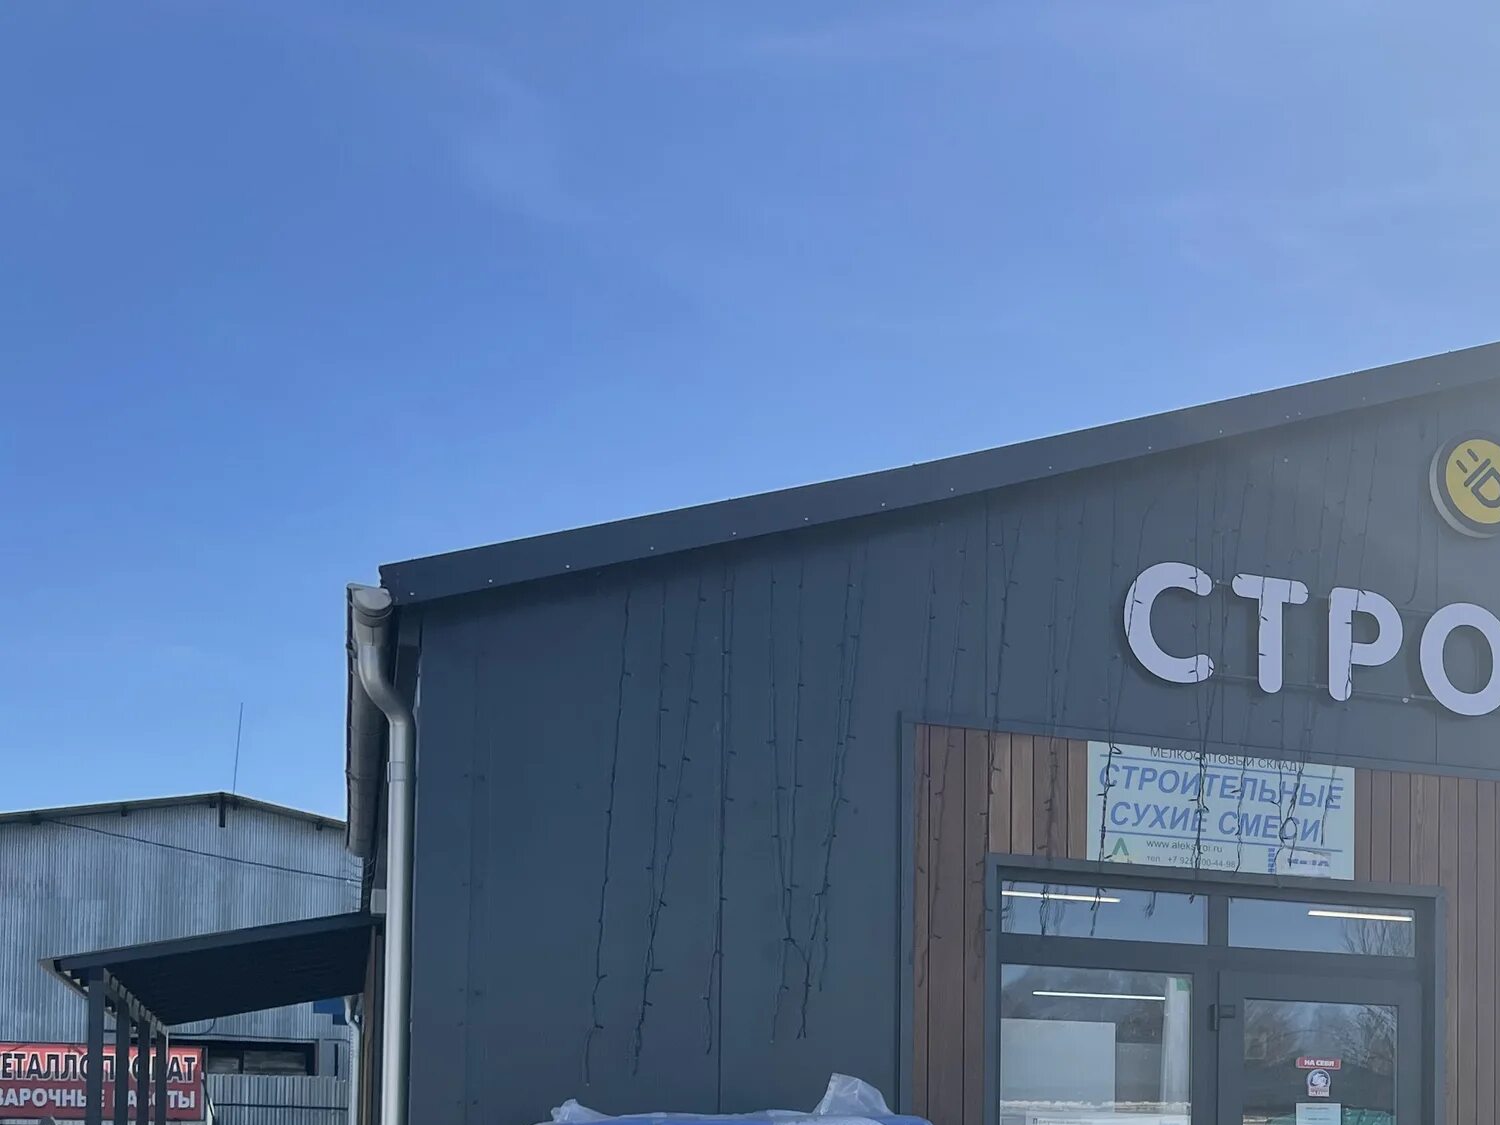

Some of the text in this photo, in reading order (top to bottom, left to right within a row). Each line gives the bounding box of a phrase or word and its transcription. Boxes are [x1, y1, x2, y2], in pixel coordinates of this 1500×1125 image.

[1100, 764, 1344, 809] СТРОИТЕЛЬНЫЕ
[1110, 801, 1321, 843] СУХИЕ СМЕСИ
